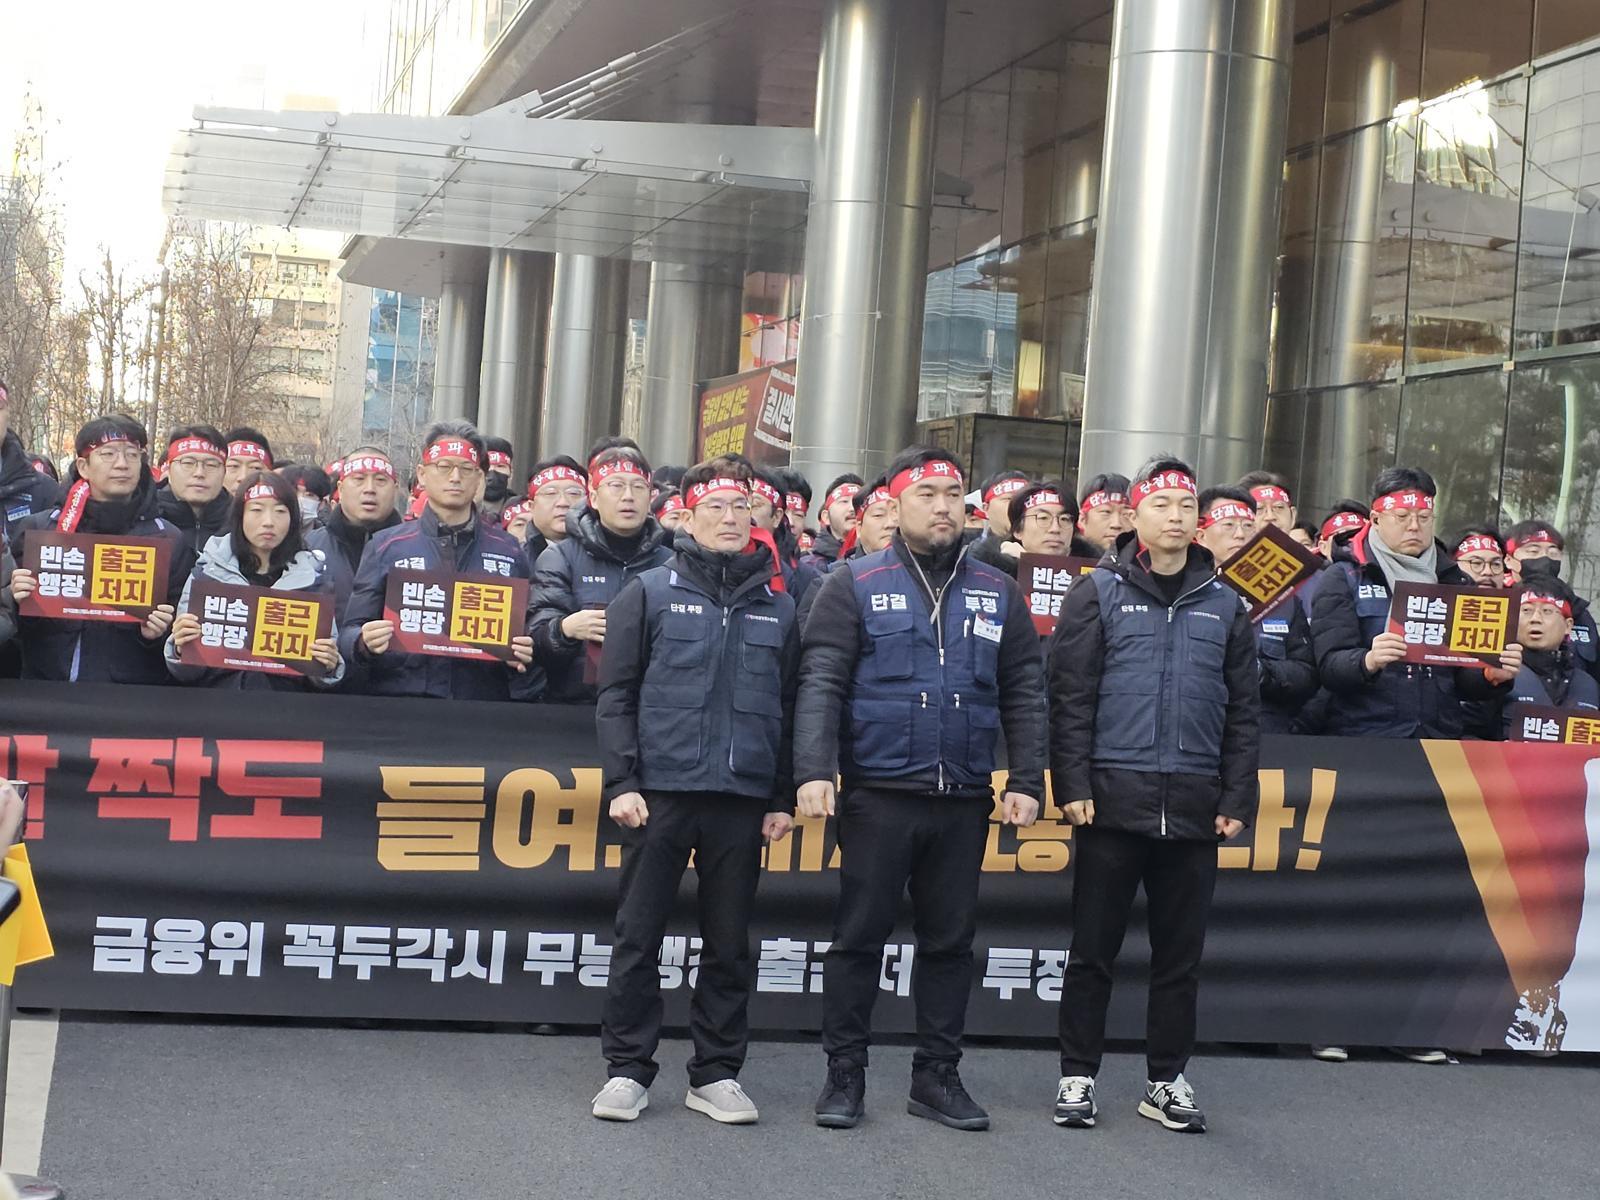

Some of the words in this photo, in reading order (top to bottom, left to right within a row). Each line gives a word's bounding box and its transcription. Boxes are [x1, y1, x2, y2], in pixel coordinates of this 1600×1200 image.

[534, 469, 553, 485] 단결
[993, 482, 1012, 495] 단결
[1141, 474, 1165, 494] 단결
[832, 486, 859, 499] 총파
[1024, 492, 1045, 508] 단결
[1211, 504, 1235, 521] 단결
[40, 545, 85, 571] 빈손
[1459, 537, 1481, 553] 단결
[100, 547, 147, 574] 출근
[485, 559, 511, 576] 투쟁
[1232, 543, 1277, 583] 출근
[38, 572, 85, 598] 행장
[97, 577, 146, 604] 저지
[1032, 567, 1072, 591] 빈손
[1252, 558, 1297, 597] 저지
[402, 581, 446, 608] 빈손
[460, 585, 505, 612] 출근
[871, 593, 907, 611] 단결
[965, 596, 997, 613] 투쟁
[1359, 585, 1388, 598] 단결
[204, 595, 249, 623] 빈손
[263, 601, 310, 629] 출근
[670, 603, 686, 614] 단결
[687, 604, 702, 614] 투쟁
[1406, 595, 1447, 620] 빈손
[1461, 598, 1502, 624] 출근
[399, 608, 445, 635] 행장
[456, 616, 503, 644] 저지
[1404, 620, 1446, 645] 행장
[201, 622, 247, 649] 행장
[259, 631, 309, 657] 저지
[1458, 627, 1499, 651] 저지
[1523, 716, 1560, 741] 빈손
[86, 737, 324, 841] 짝도
[93, 916, 264, 977] 금융위
[282, 923, 507, 984] 꼭두각시
